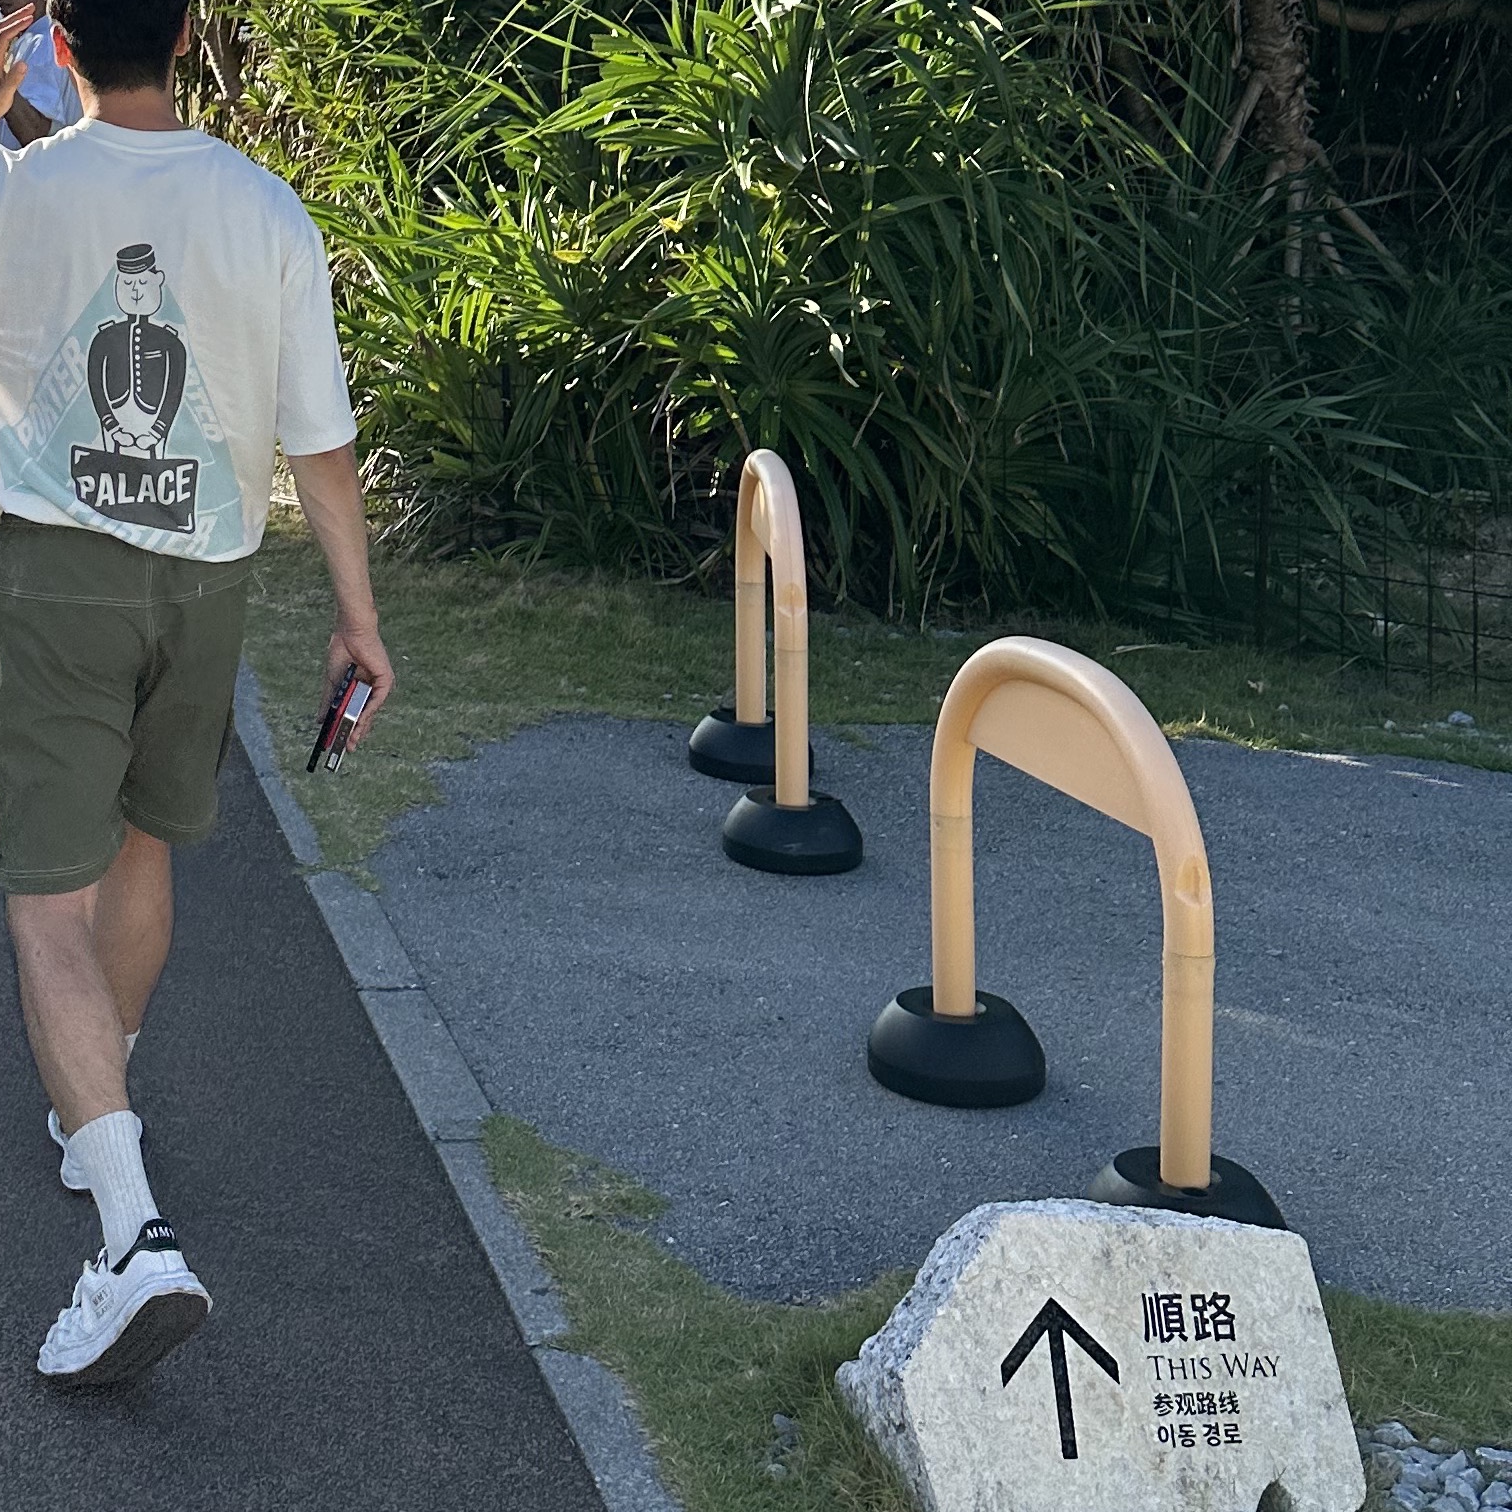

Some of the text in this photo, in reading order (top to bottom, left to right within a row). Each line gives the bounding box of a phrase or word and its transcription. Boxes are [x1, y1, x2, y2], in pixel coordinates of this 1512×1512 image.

[76, 463, 194, 507] PALACE
[1141, 1291, 1236, 1343] 順路
[1147, 1353, 1280, 1380] THIS WAY
[1153, 1390, 1240, 1416] 参观路线
[1157, 1422, 1242, 1448] 이동 경로
